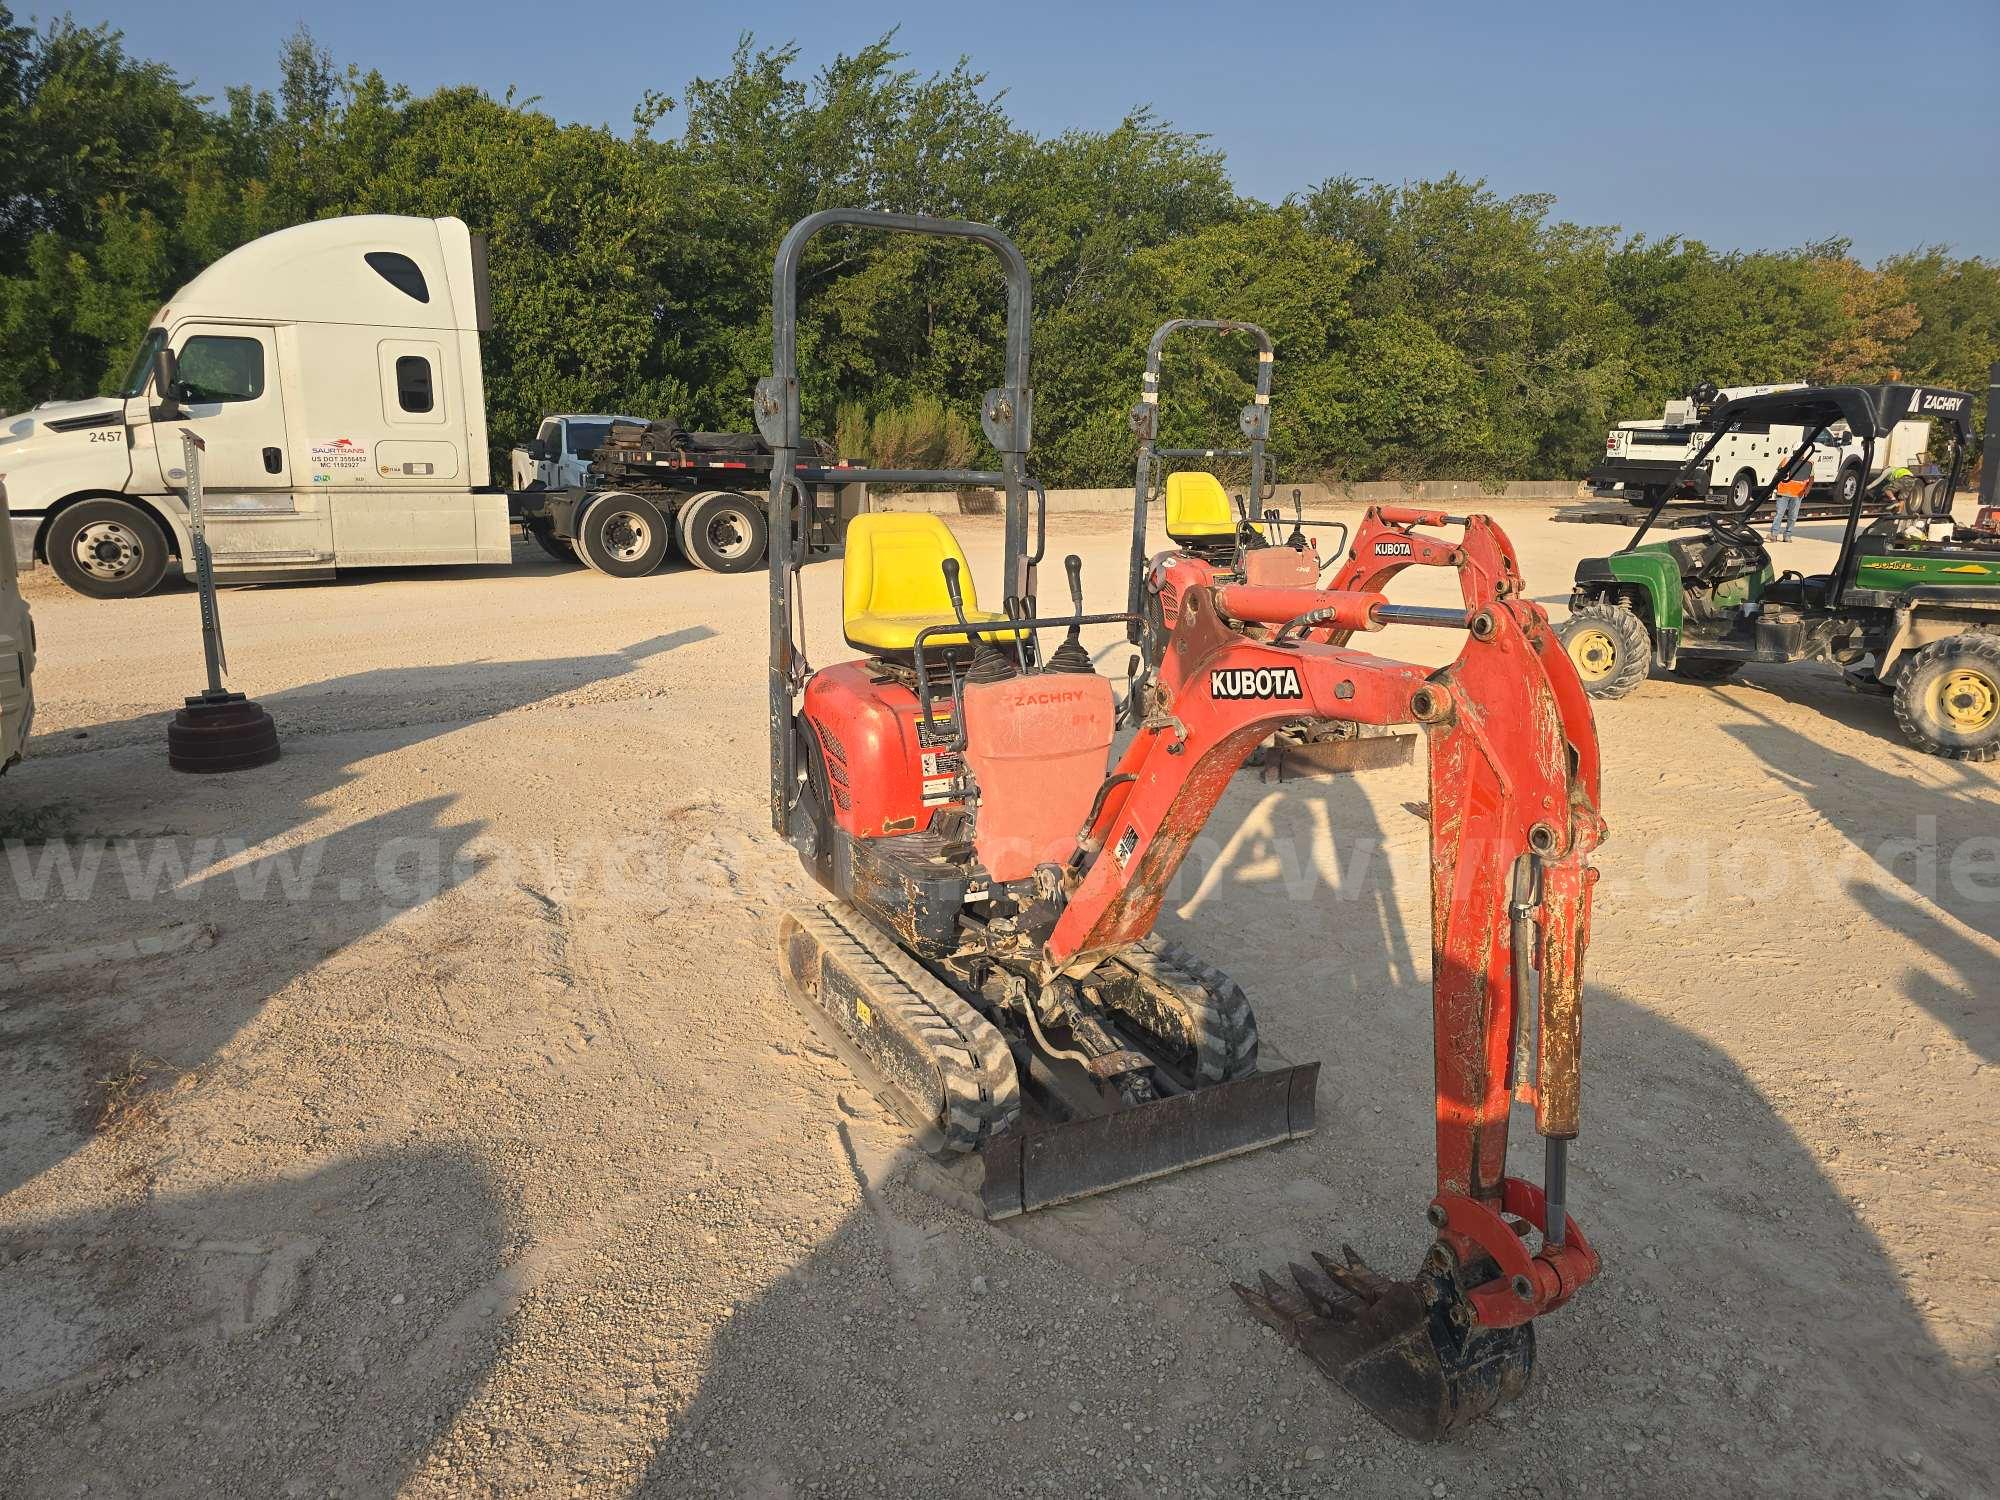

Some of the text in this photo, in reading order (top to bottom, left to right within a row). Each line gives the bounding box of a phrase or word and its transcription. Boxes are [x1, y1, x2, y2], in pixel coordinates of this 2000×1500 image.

[1924, 395, 1964, 411] ZACHRY
[89, 431, 122, 443] 2457
[1375, 543, 1411, 556] KUBOTA
[1211, 668, 1302, 698] KUBOTA
[1014, 689, 1084, 706] ZACHRY
